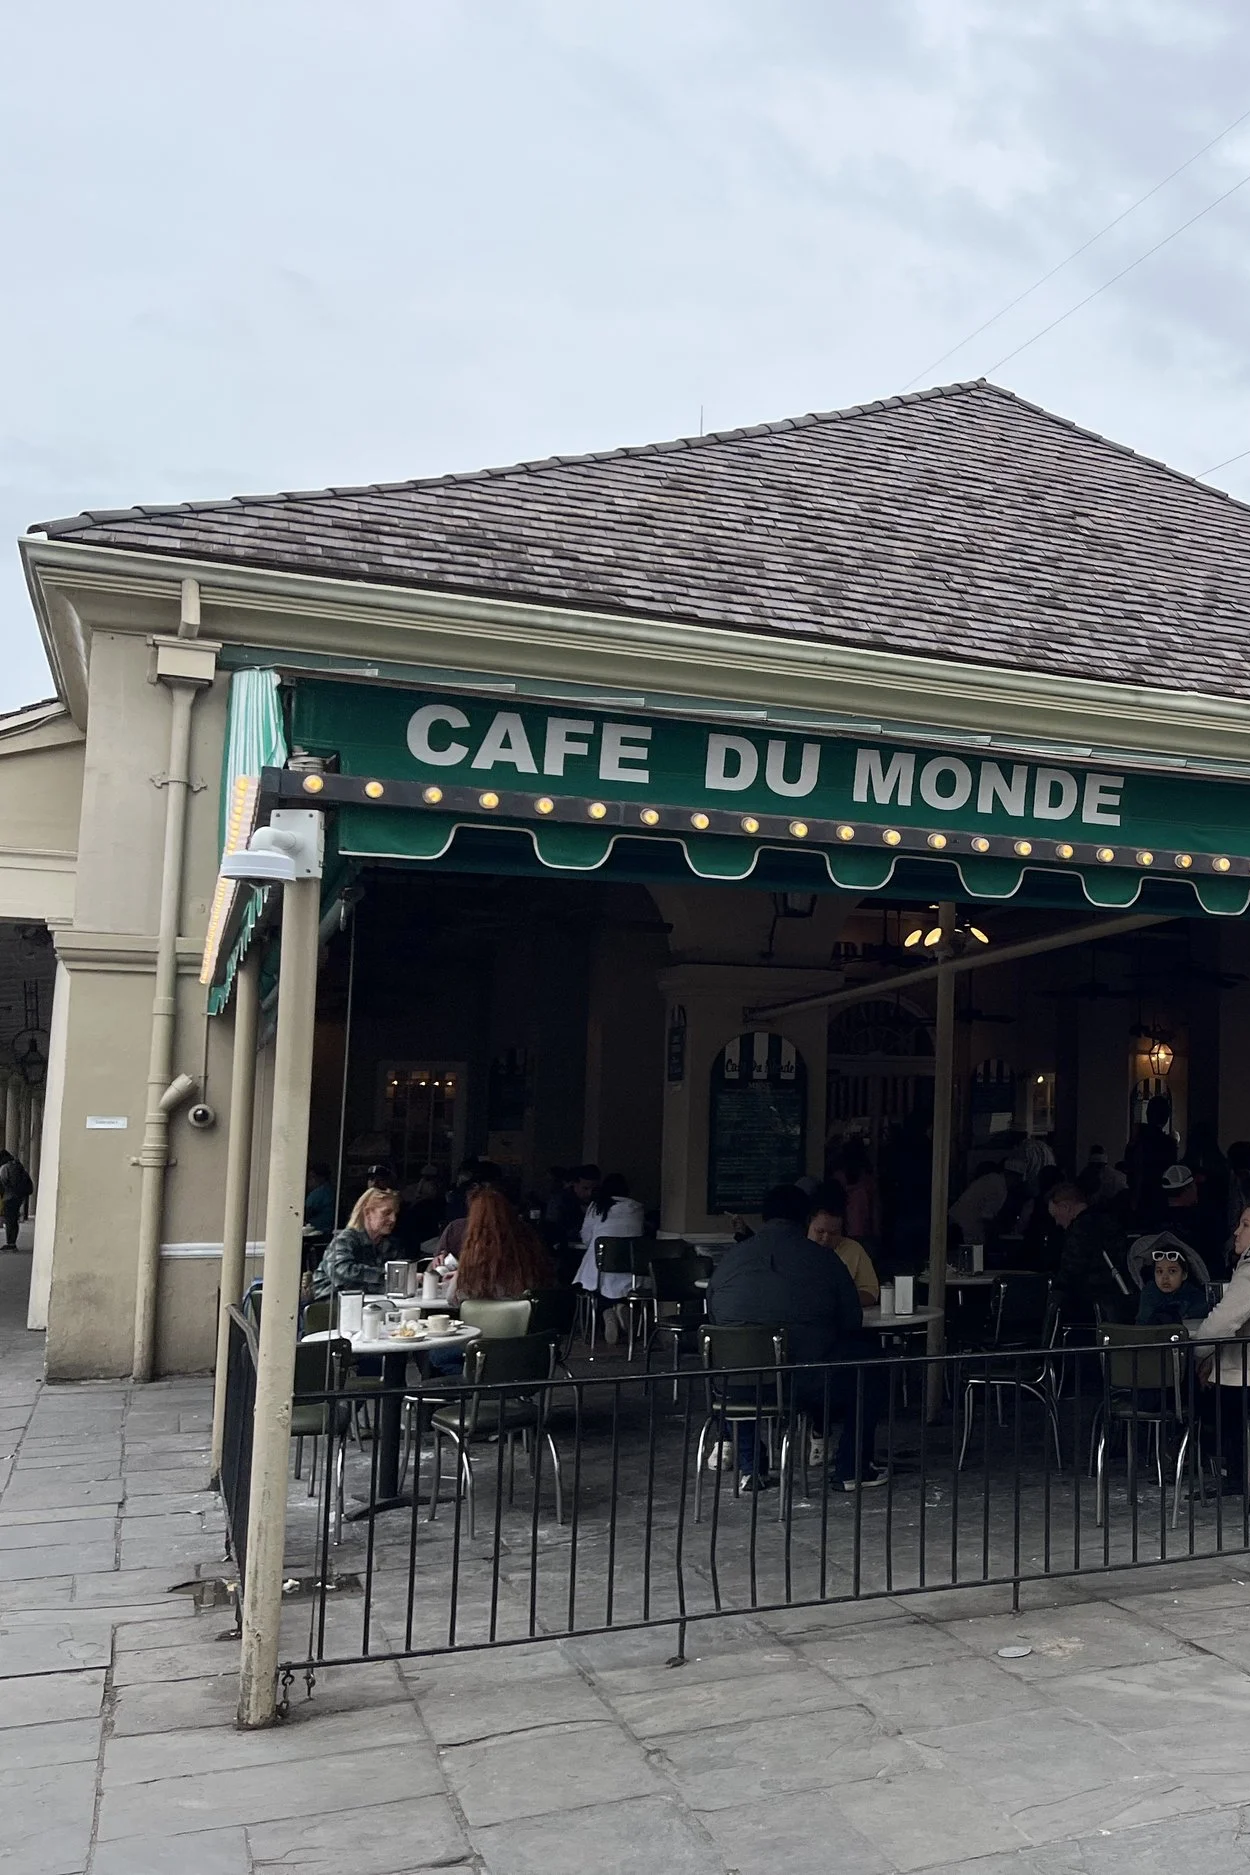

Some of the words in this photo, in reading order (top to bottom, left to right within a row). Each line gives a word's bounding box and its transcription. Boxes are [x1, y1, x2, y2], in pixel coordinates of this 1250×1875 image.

[405, 704, 652, 784] CAFE
[704, 733, 821, 798] DU
[852, 748, 1125, 827] MONDE
